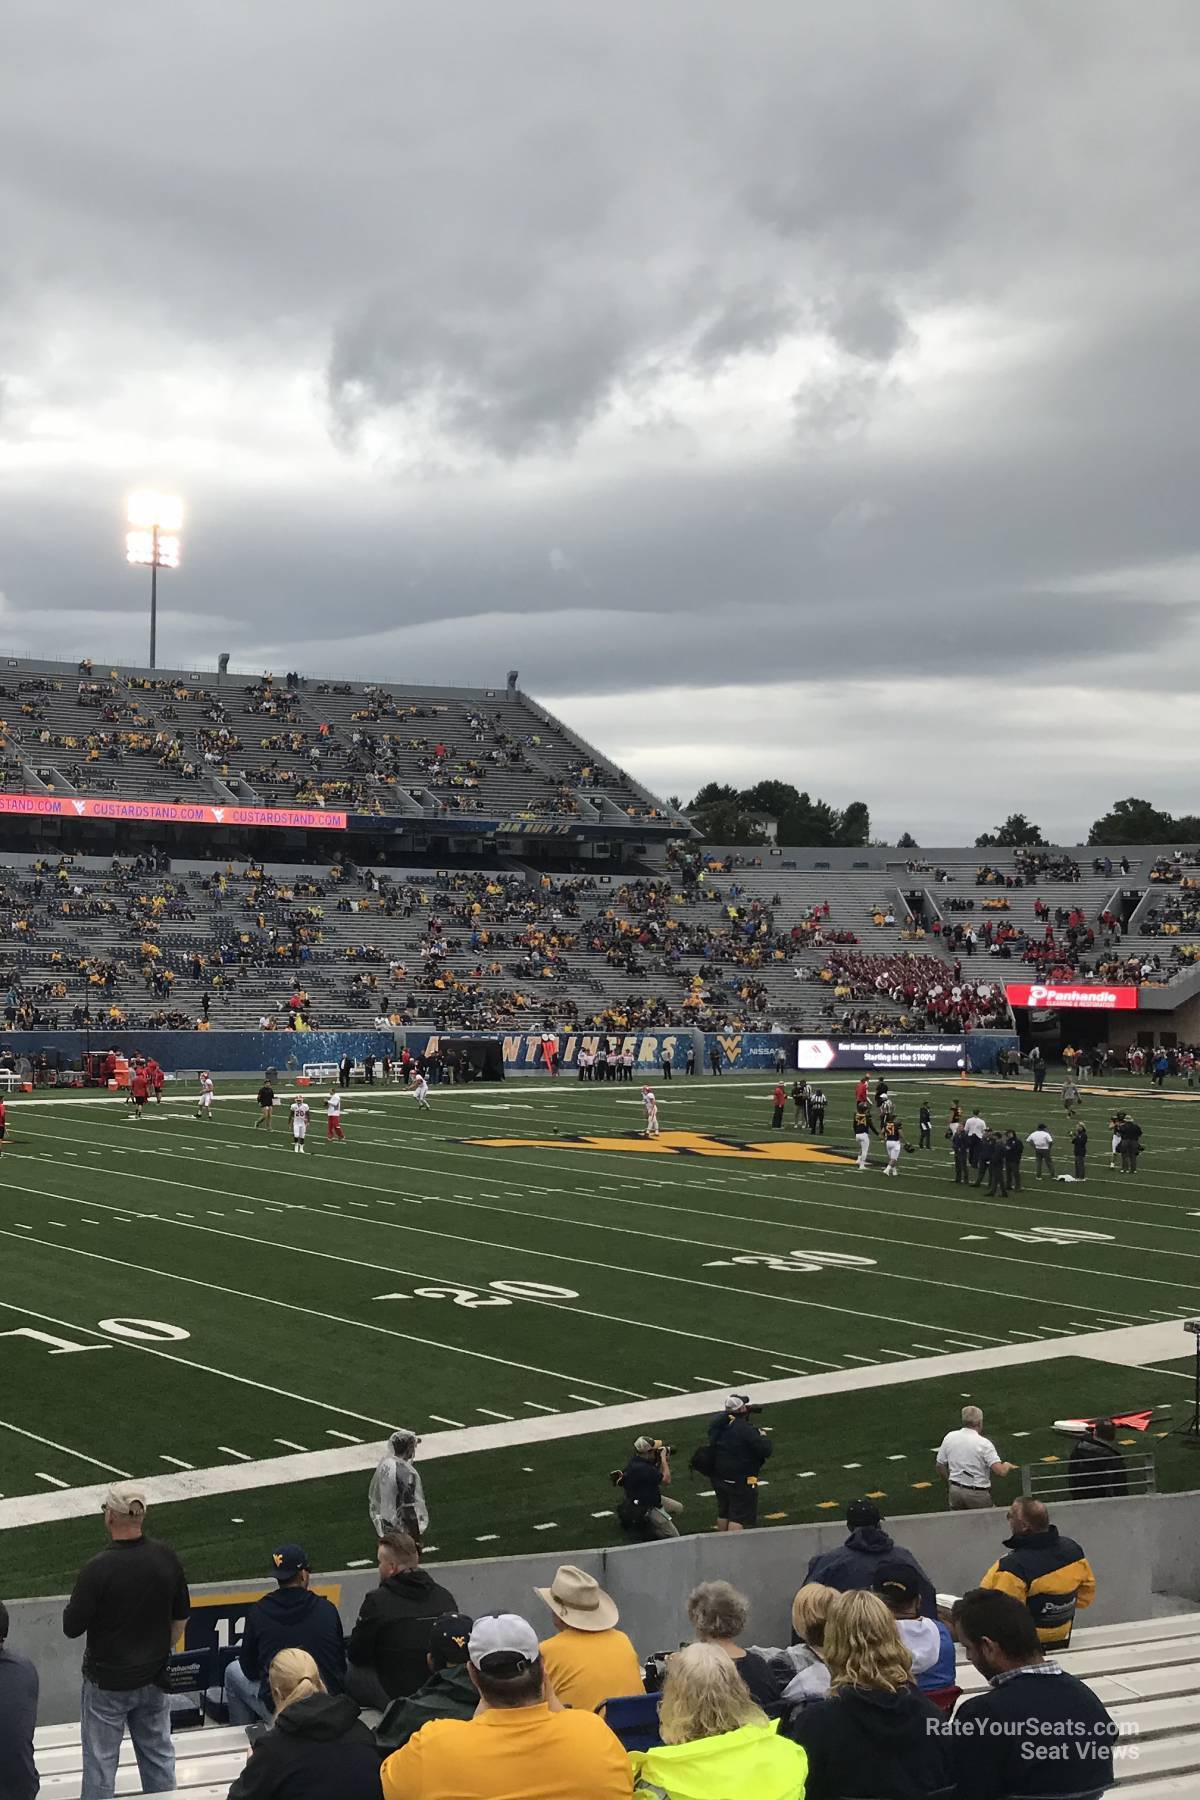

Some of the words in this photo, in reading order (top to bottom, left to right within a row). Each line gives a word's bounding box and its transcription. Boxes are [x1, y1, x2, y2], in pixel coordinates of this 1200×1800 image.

[93, 803, 204, 820] CUSTARDSTAND.COM
[232, 810, 341, 826] CUSTARDSTAND.COM
[1047, 990, 1117, 1002] Panhandle
[749, 1047, 776, 1055] NISSA
[863, 1053, 891, 1062] Starting
[900, 1053, 911, 1061] the
[994, 1227, 1116, 1245] 40
[731, 1250, 878, 1272] 30
[413, 1280, 580, 1309] 20
